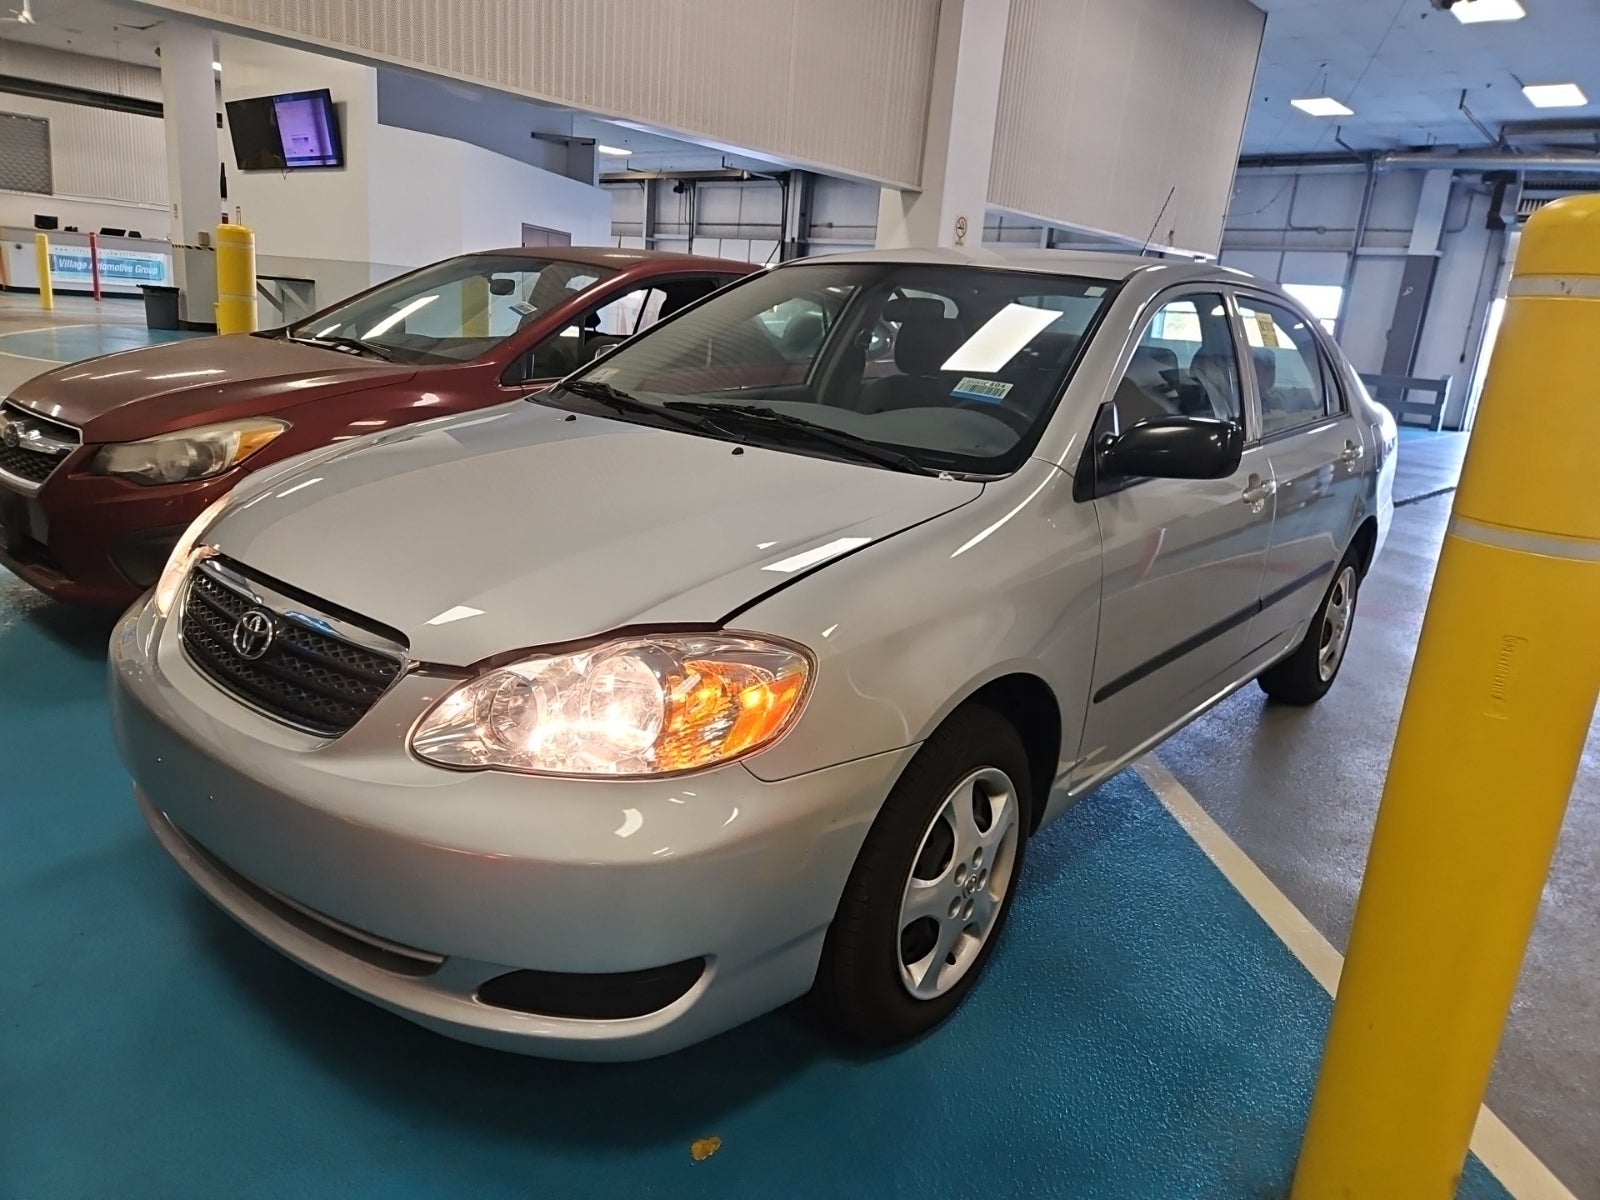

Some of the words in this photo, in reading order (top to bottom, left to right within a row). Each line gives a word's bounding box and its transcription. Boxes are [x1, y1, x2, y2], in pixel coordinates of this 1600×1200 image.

[59, 259, 87, 270] Village
[89, 260, 133, 272] tomotive
[135, 264, 158, 276] Group
